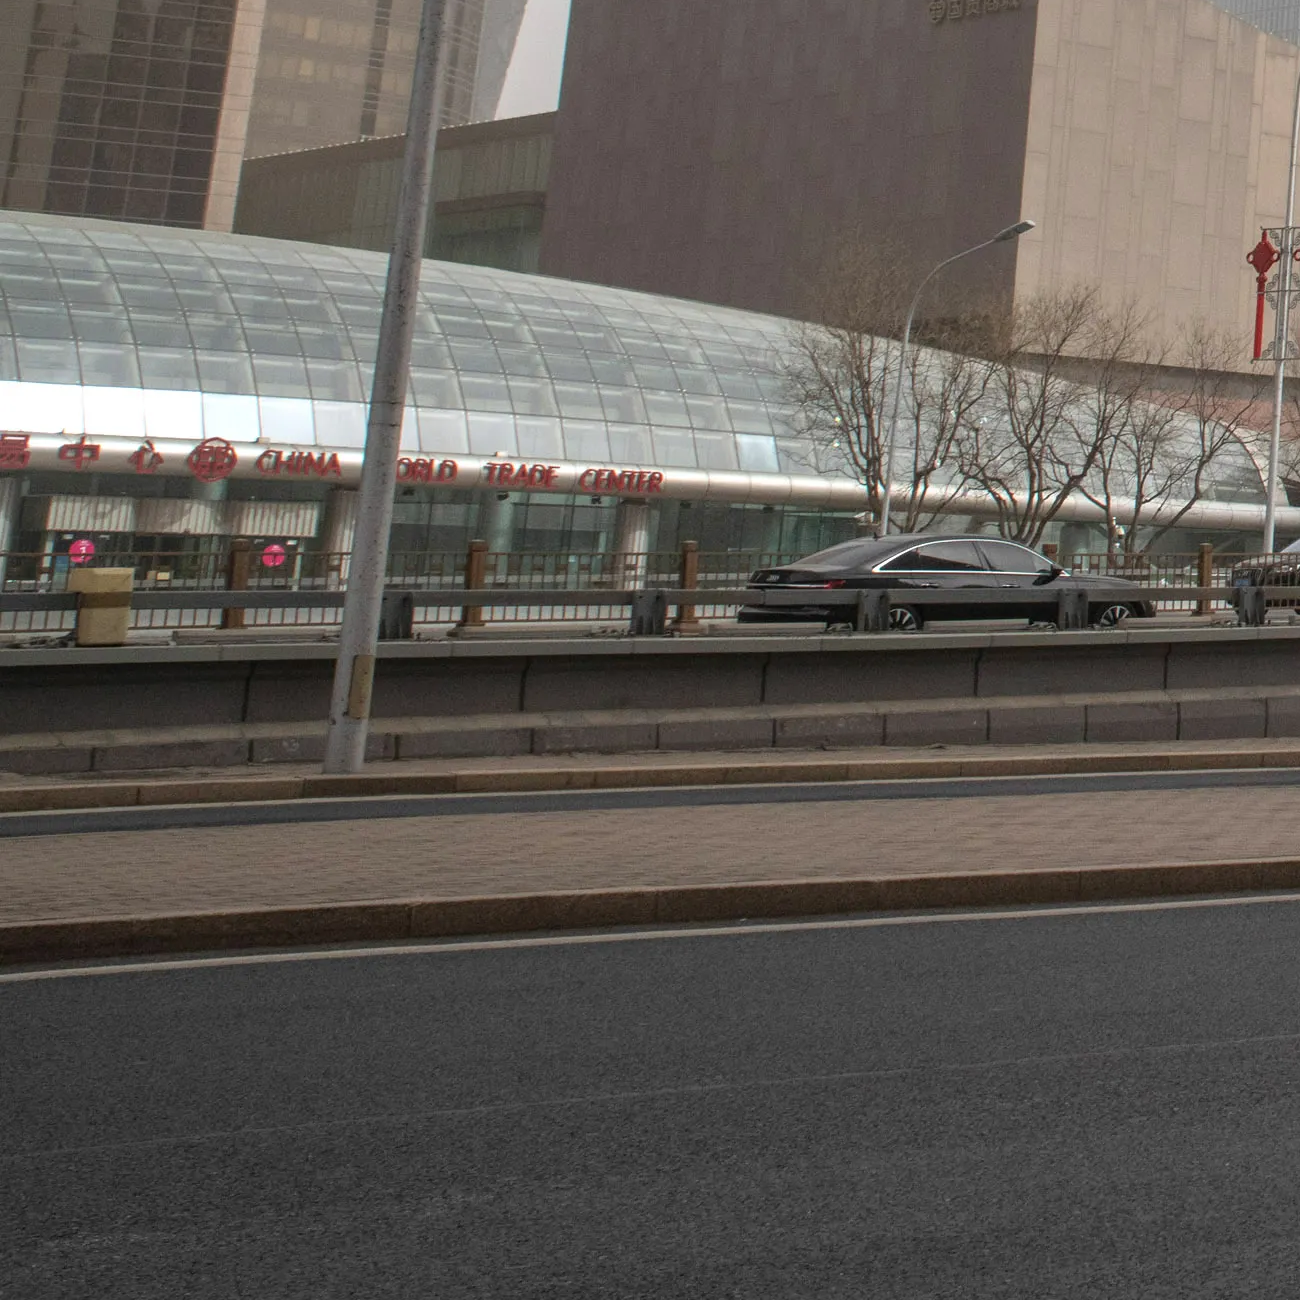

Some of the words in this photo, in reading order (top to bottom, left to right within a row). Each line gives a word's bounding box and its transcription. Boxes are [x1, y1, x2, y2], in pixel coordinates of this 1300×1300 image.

[256, 450, 342, 477] CHINA
[396, 457, 458, 483] ORLD
[485, 462, 561, 489] TRADE
[579, 468, 664, 493] CENTER
